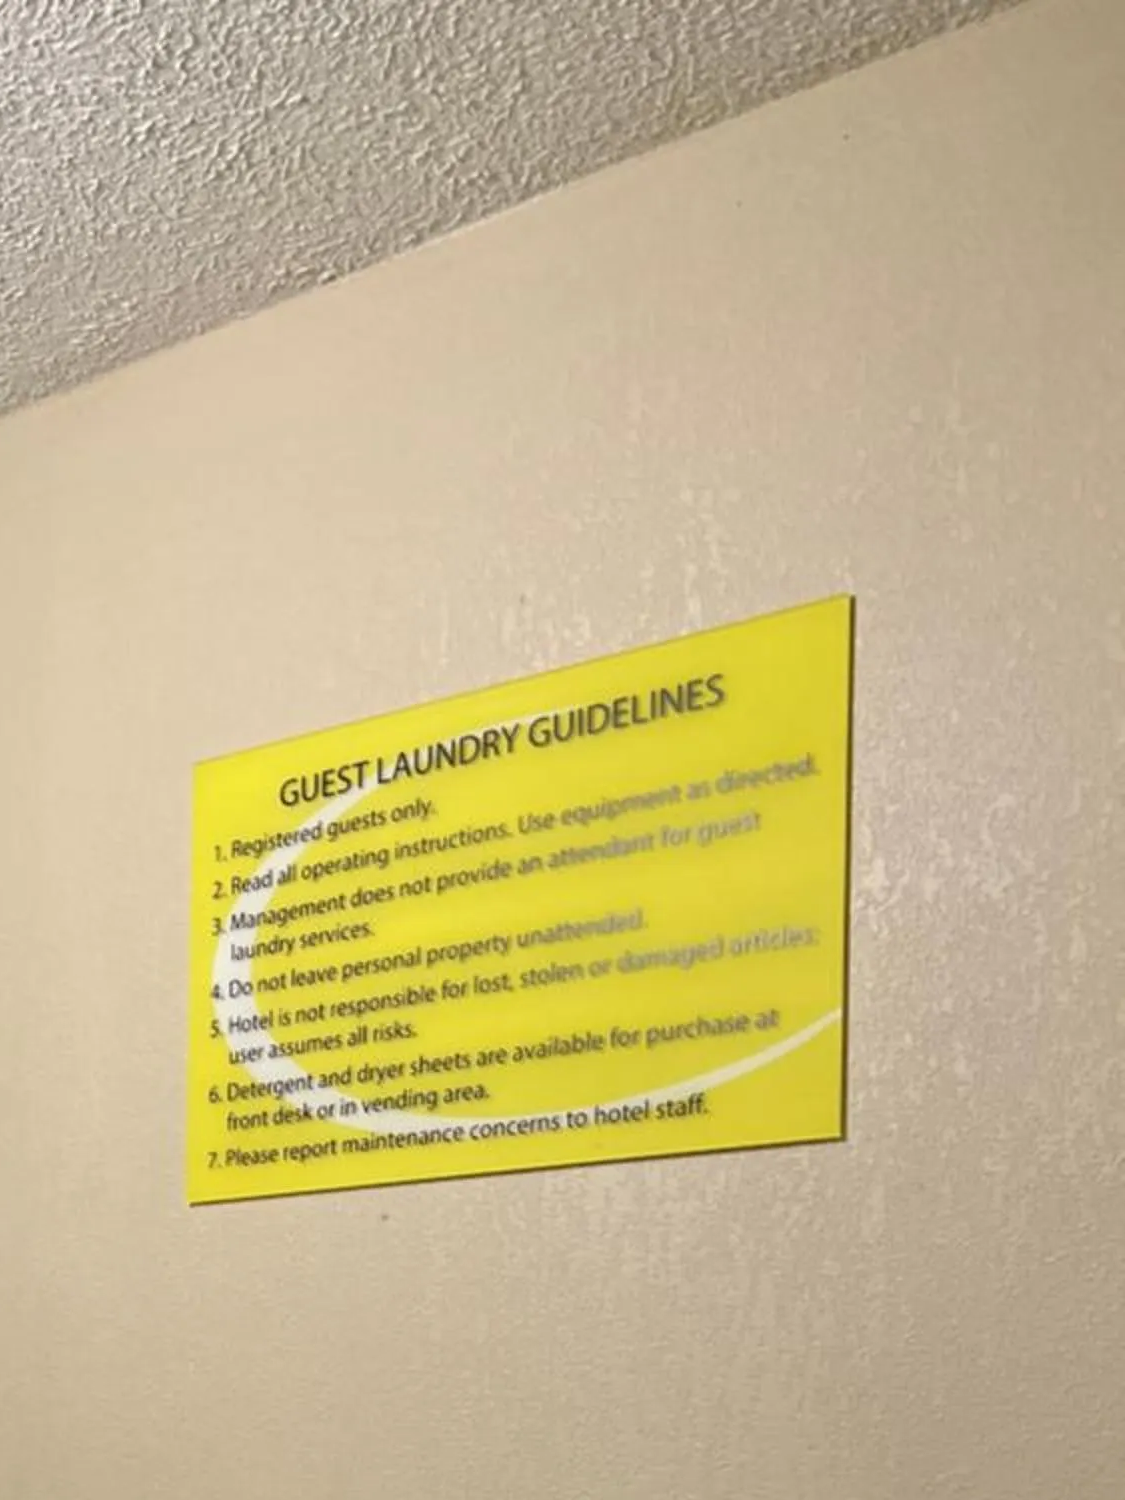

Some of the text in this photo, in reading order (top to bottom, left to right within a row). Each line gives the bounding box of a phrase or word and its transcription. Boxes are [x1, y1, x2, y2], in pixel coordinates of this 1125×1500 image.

[279, 673, 726, 807] GUEST LAUNDRY GUIDELINES
[212, 752, 820, 900] 2. Read all operating instructions. Use equipment as directed.
[214, 798, 436, 862] 1. Registered guests only.
[211, 810, 762, 937] 3. Management does not provide an attendant for guest
[210, 1020, 223, 1038] 5.
[228, 1010, 274, 1035] Hotel
[278, 1007, 291, 1026] is
[295, 1002, 327, 1026] not
[330, 984, 438, 1020] responsible
[441, 979, 469, 1001] for
[473, 973, 514, 995] lost,
[520, 960, 584, 988] stolen
[588, 957, 613, 979] or
[616, 936, 725, 975] damaged
[211, 906, 648, 1000] 4. Do not leave personal property unattended.
[230, 920, 374, 962] laundry services.
[208, 1008, 780, 1104] 6. Detergent and dryer sheets are available for purchase at
[228, 1020, 418, 1065] user assumes all risks.
[207, 1091, 710, 1169] 7. Please report maintenance concerns to hotel staff.
[226, 1083, 490, 1133] front desk or in vending area.
